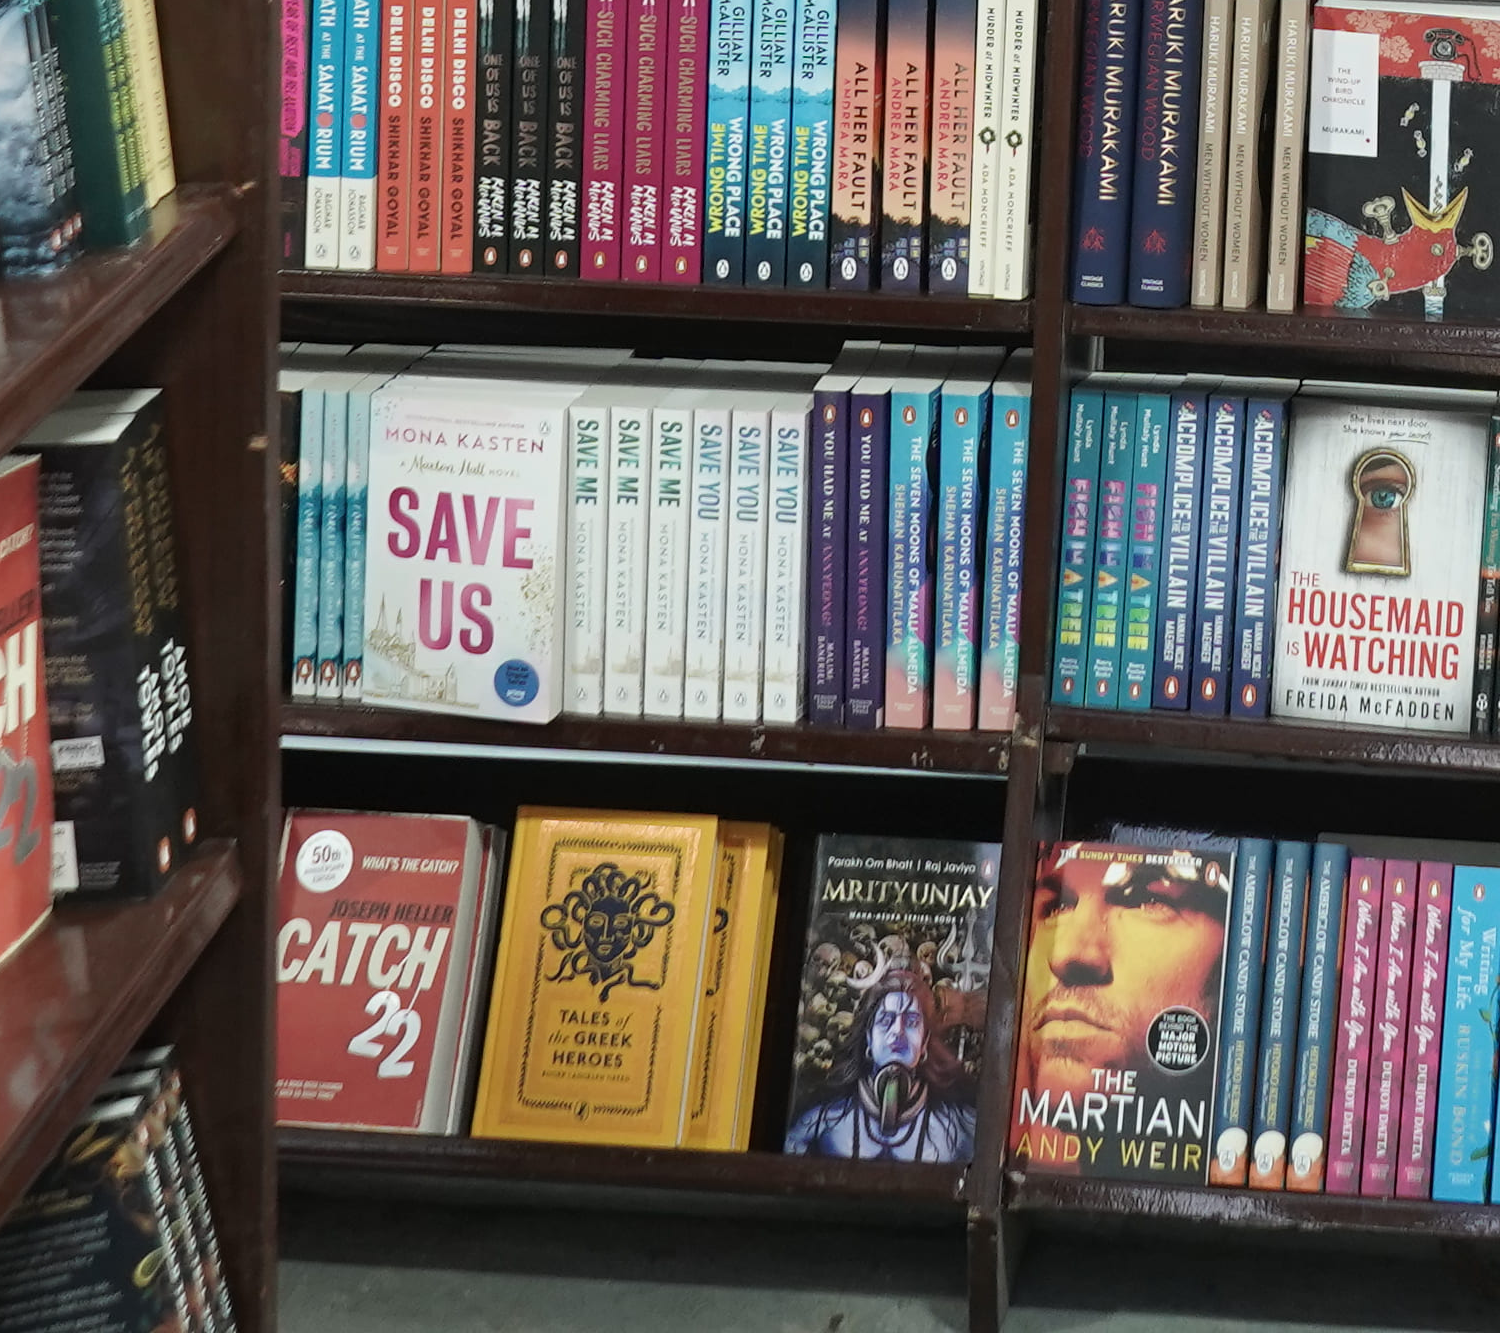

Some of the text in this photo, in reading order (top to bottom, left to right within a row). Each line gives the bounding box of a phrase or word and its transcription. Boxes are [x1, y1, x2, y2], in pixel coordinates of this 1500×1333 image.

[574, 417, 601, 508] SAVE ME
[387, 486, 535, 571] SAVE
[1289, 570, 1320, 588] THE
[419, 577, 496, 656] US
[1287, 587, 1465, 637] HOUSEMAID
[1286, 632, 1459, 682] IS WATCHING
[821, 876, 992, 911] MRITYUNJAY
[349, 990, 423, 1079] 22
[548, 1030, 633, 1049] the GREEK
[559, 1009, 633, 1028] TALES of
[553, 1050, 624, 1069] HEROES
[1091, 1068, 1137, 1095] THE
[1018, 1088, 1205, 1139] MARTIAN
[1015, 1135, 1202, 1171] ANDY WEIR
